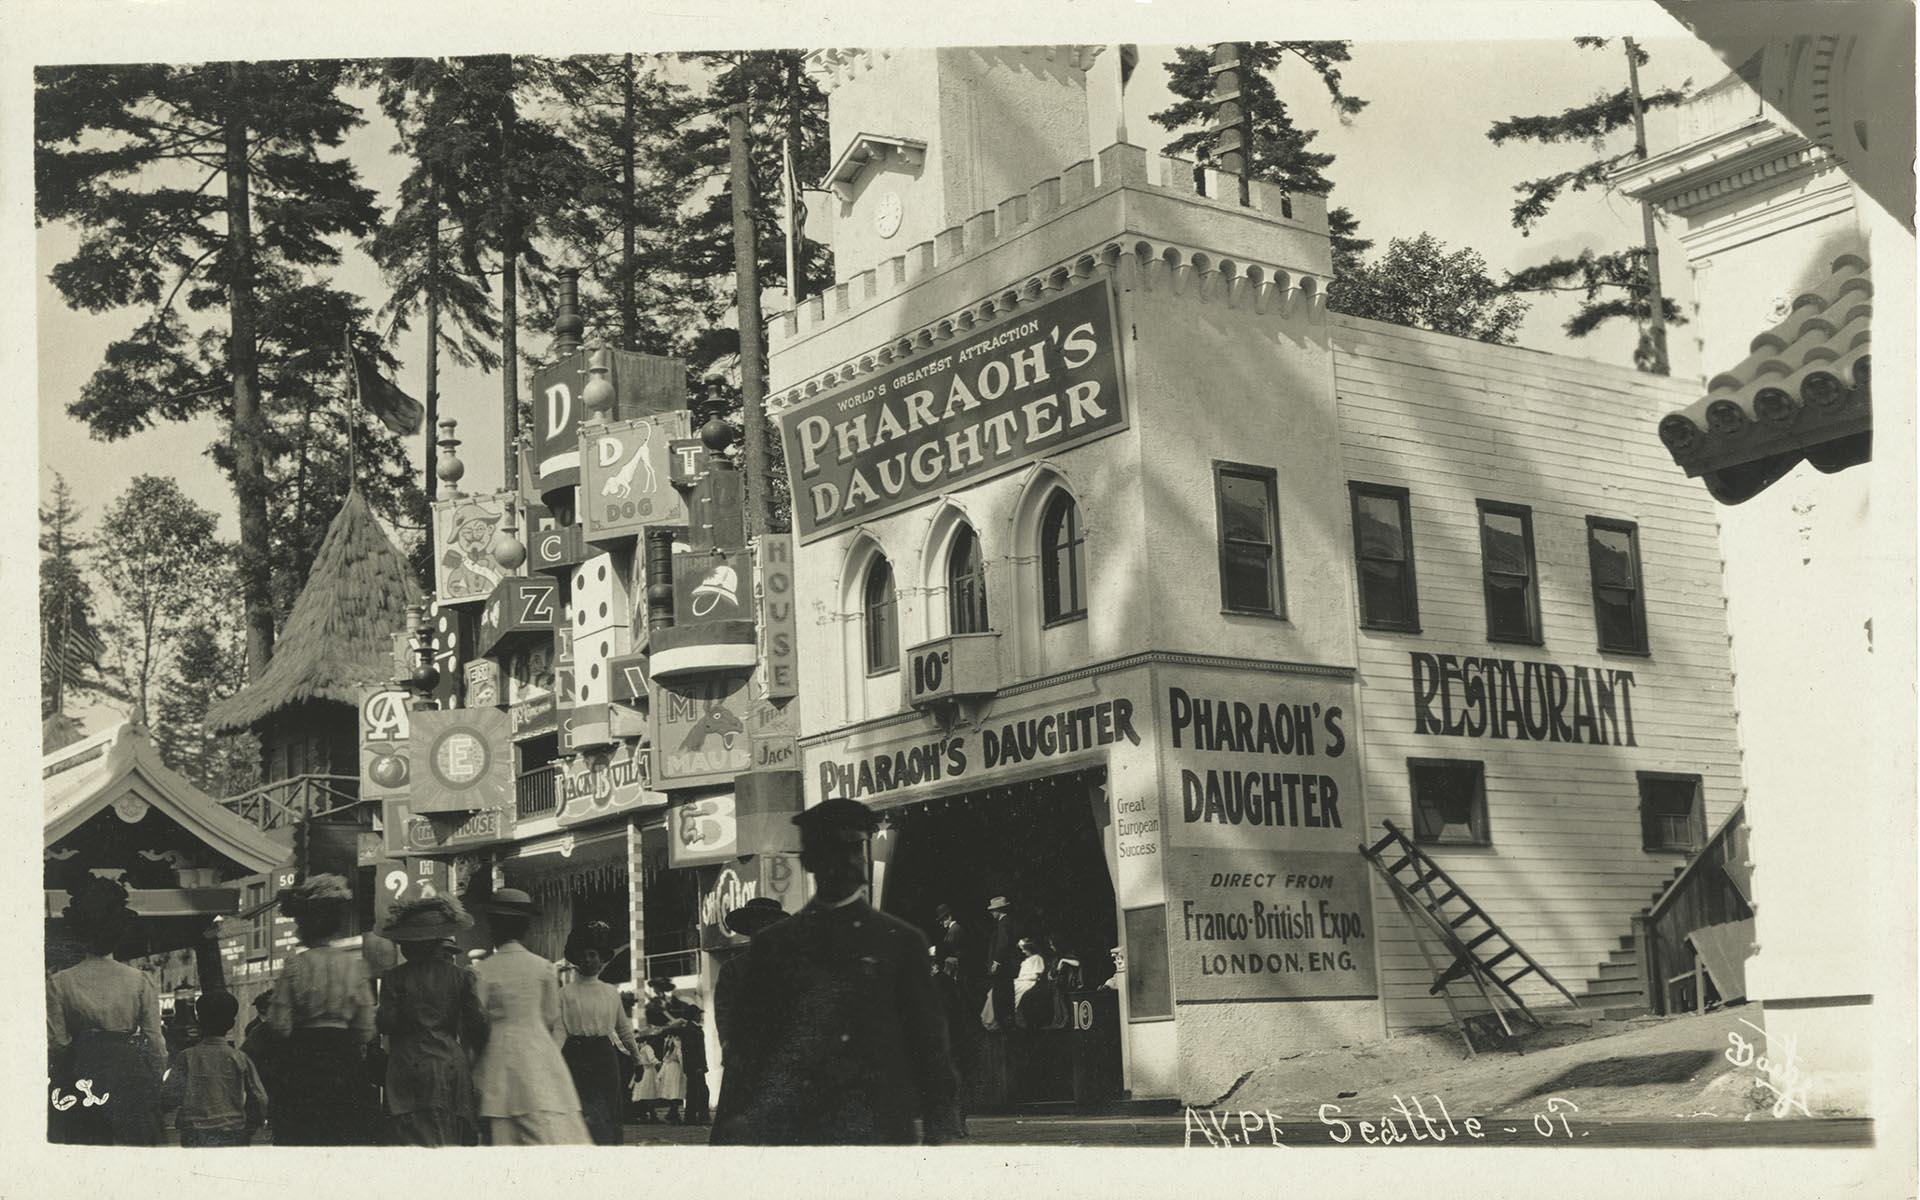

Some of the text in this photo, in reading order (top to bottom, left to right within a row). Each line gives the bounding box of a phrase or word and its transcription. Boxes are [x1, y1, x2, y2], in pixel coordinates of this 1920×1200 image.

[838, 319, 1040, 412] WORLD'S GREATEST ATTRACTION
[797, 322, 1099, 475] PHARAOH'S
[810, 380, 1109, 522] DAUGHTER
[606, 497, 653, 523] DOG
[767, 542, 791, 687] HOUSE
[1168, 686, 1347, 758] PHARAOH'S
[1408, 651, 1639, 748] RESTAURANT
[757, 742, 793, 766] JACK
[819, 698, 1142, 801] PHARAOH'S DAUGHTER
[1117, 797, 1146, 815] Great
[1181, 768, 1343, 829] DAUGHTER
[1117, 818, 1159, 838] European
[1118, 842, 1157, 858] Success
[1210, 872, 1334, 889] DIRECT FROM
[1319, 900, 1366, 945] Expo.
[1308, 951, 1357, 972] ENG.
[1072, 1000, 1094, 1030] 10
